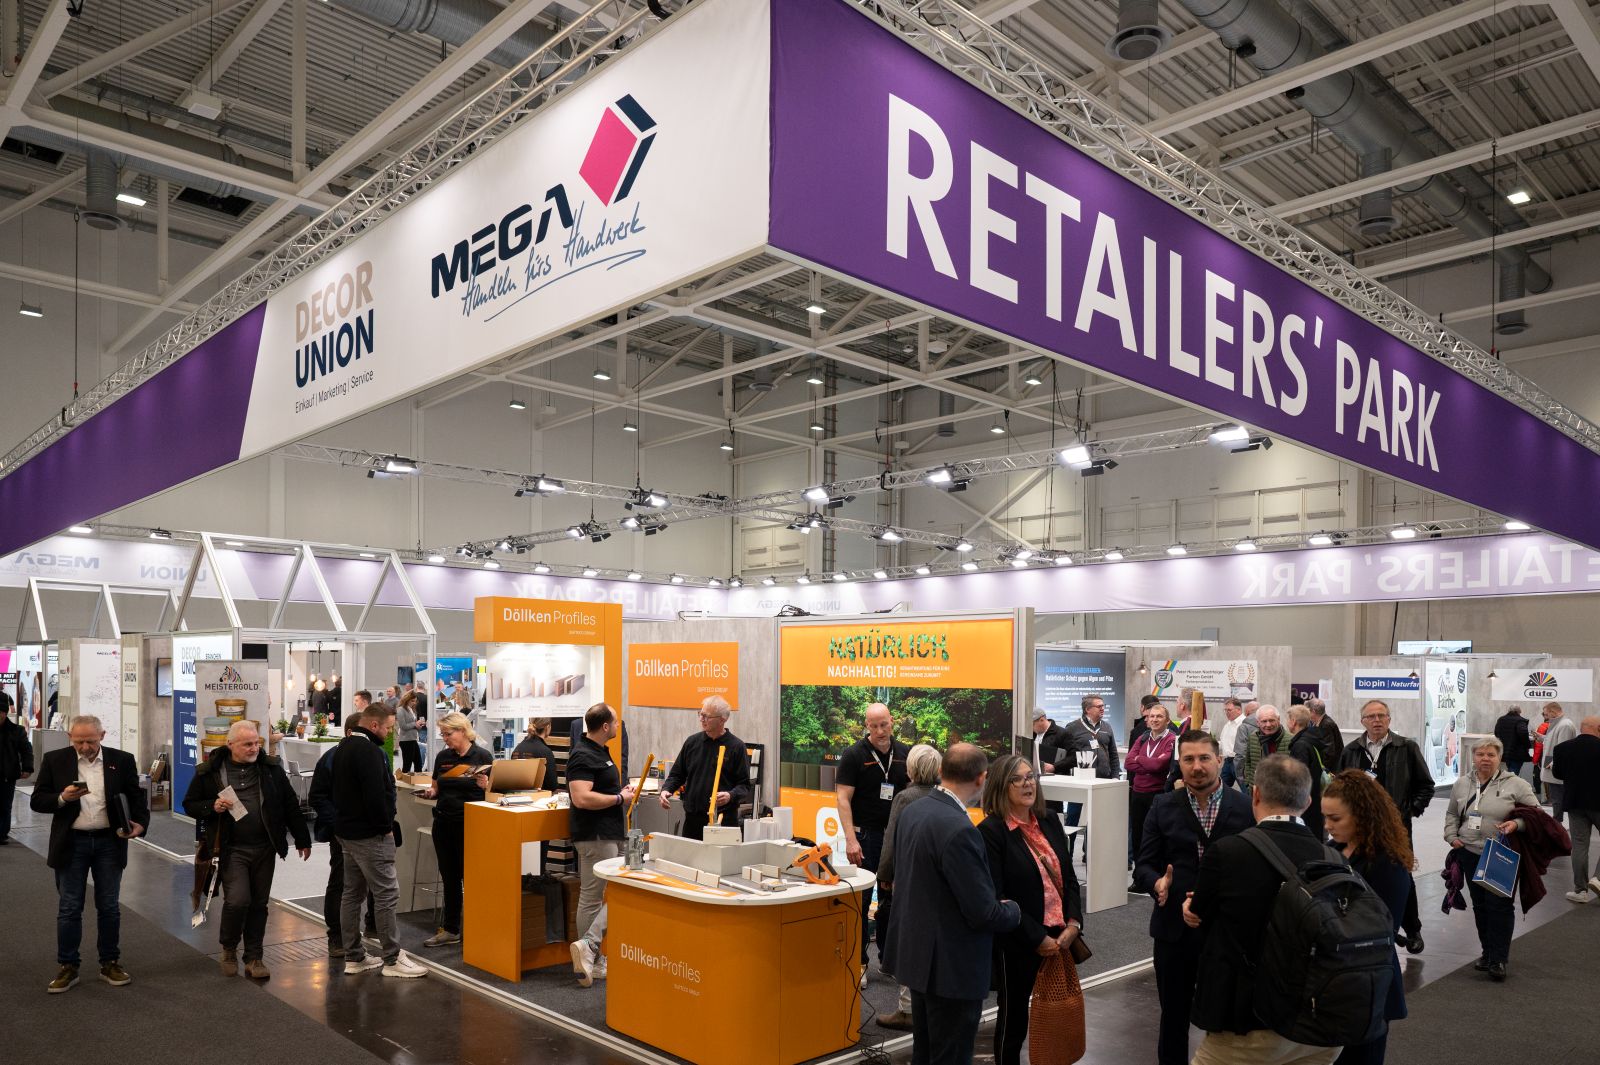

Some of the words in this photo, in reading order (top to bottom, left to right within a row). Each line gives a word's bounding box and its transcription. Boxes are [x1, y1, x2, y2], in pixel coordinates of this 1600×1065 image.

[431, 183, 574, 299] MEGA
[461, 253, 517, 318] Handeln
[525, 246, 552, 292] fürs
[562, 200, 647, 268] Handwerk
[295, 260, 374, 343] DECOR
[886, 92, 1323, 417] RETAILERS'
[1336, 339, 1441, 473] PARK
[295, 308, 374, 388] UNION
[295, 393, 315, 414] Einkauf
[318, 382, 347, 403] Marketing
[350, 370, 374, 388] Service
[503, 607, 551, 623] Döllken
[554, 610, 596, 626] Profiles
[828, 629, 950, 661] NATÜRLICH
[635, 659, 679, 677] Döllken
[681, 659, 729, 678] Profiles
[827, 665, 897, 679] NACHHALTIG!
[620, 943, 659, 970] Döllken
[661, 955, 701, 983] Profiles
